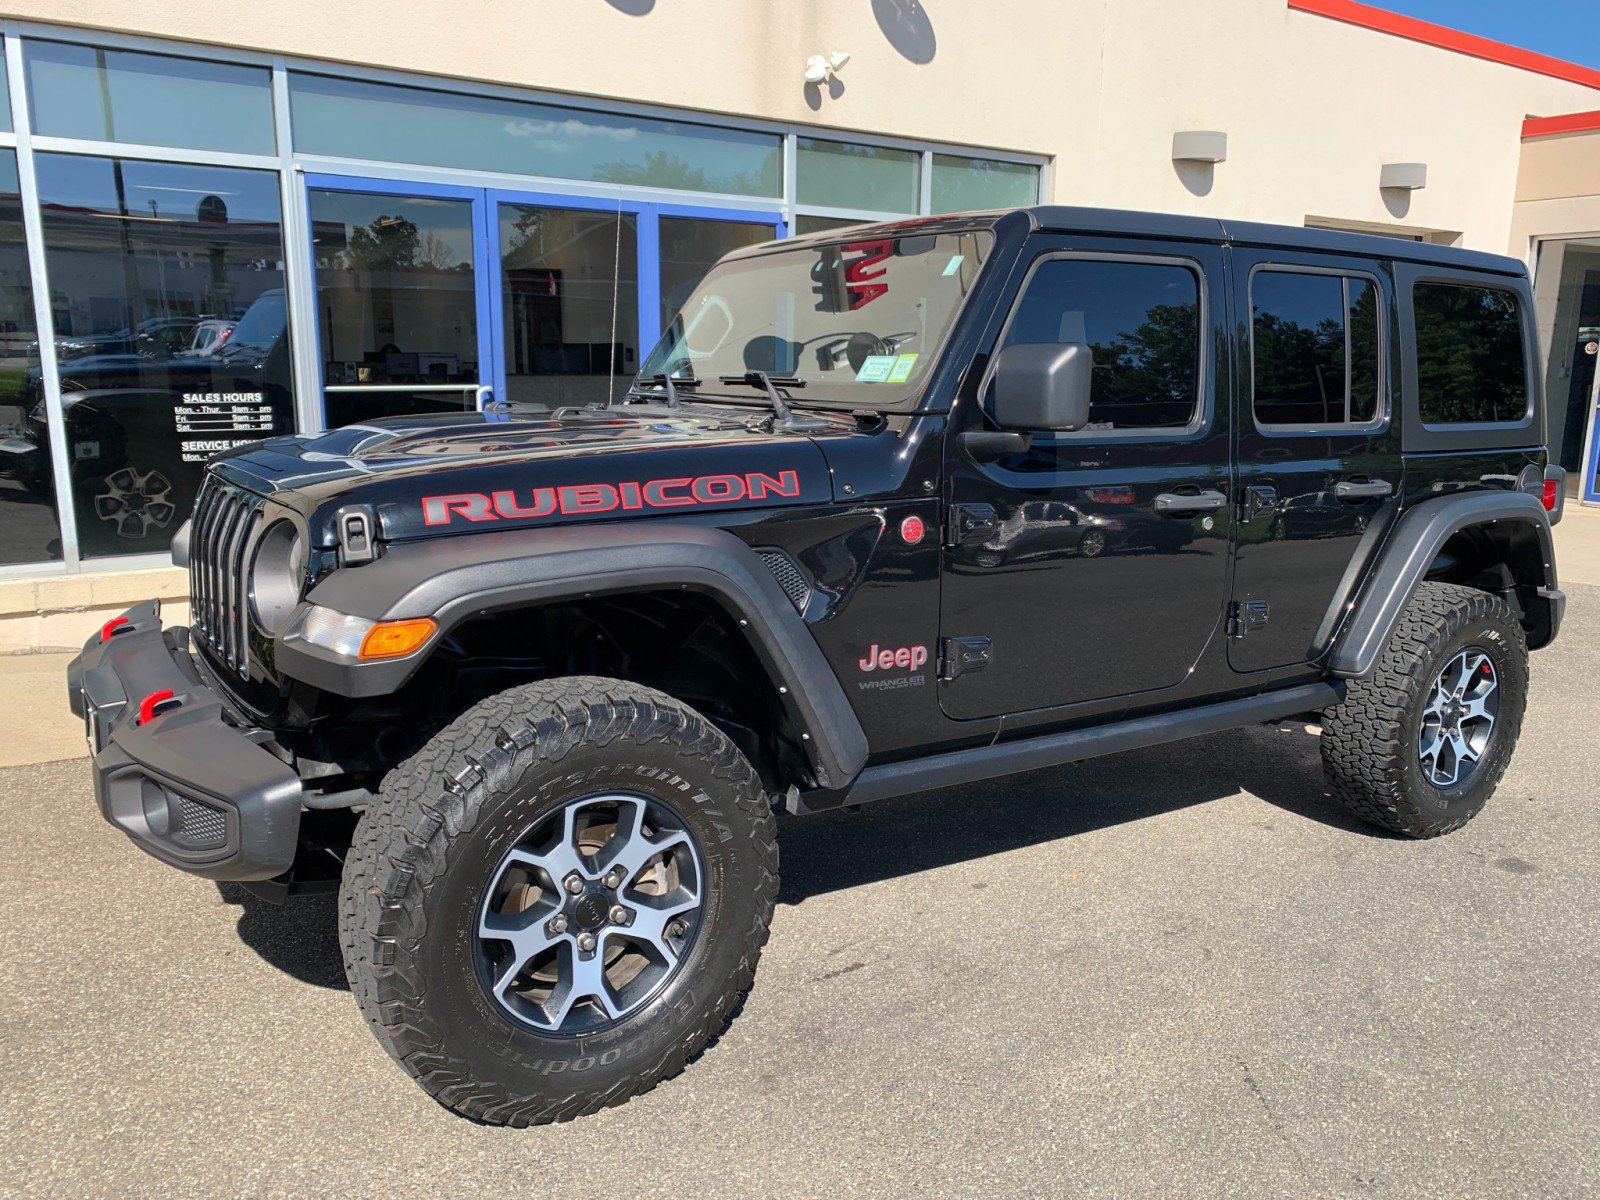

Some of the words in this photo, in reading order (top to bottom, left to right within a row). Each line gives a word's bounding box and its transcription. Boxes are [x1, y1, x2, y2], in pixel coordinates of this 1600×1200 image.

[183, 393, 220, 403] SALES
[222, 392, 262, 402] HOURS
[176, 424, 192, 432] Sat.
[181, 441, 230, 451] SERVICE
[182, 453, 202, 461] Mon.
[421, 470, 800, 526] RUBICON
[859, 644, 928, 672] Jeep
[858, 675, 925, 690] WRANGLER
